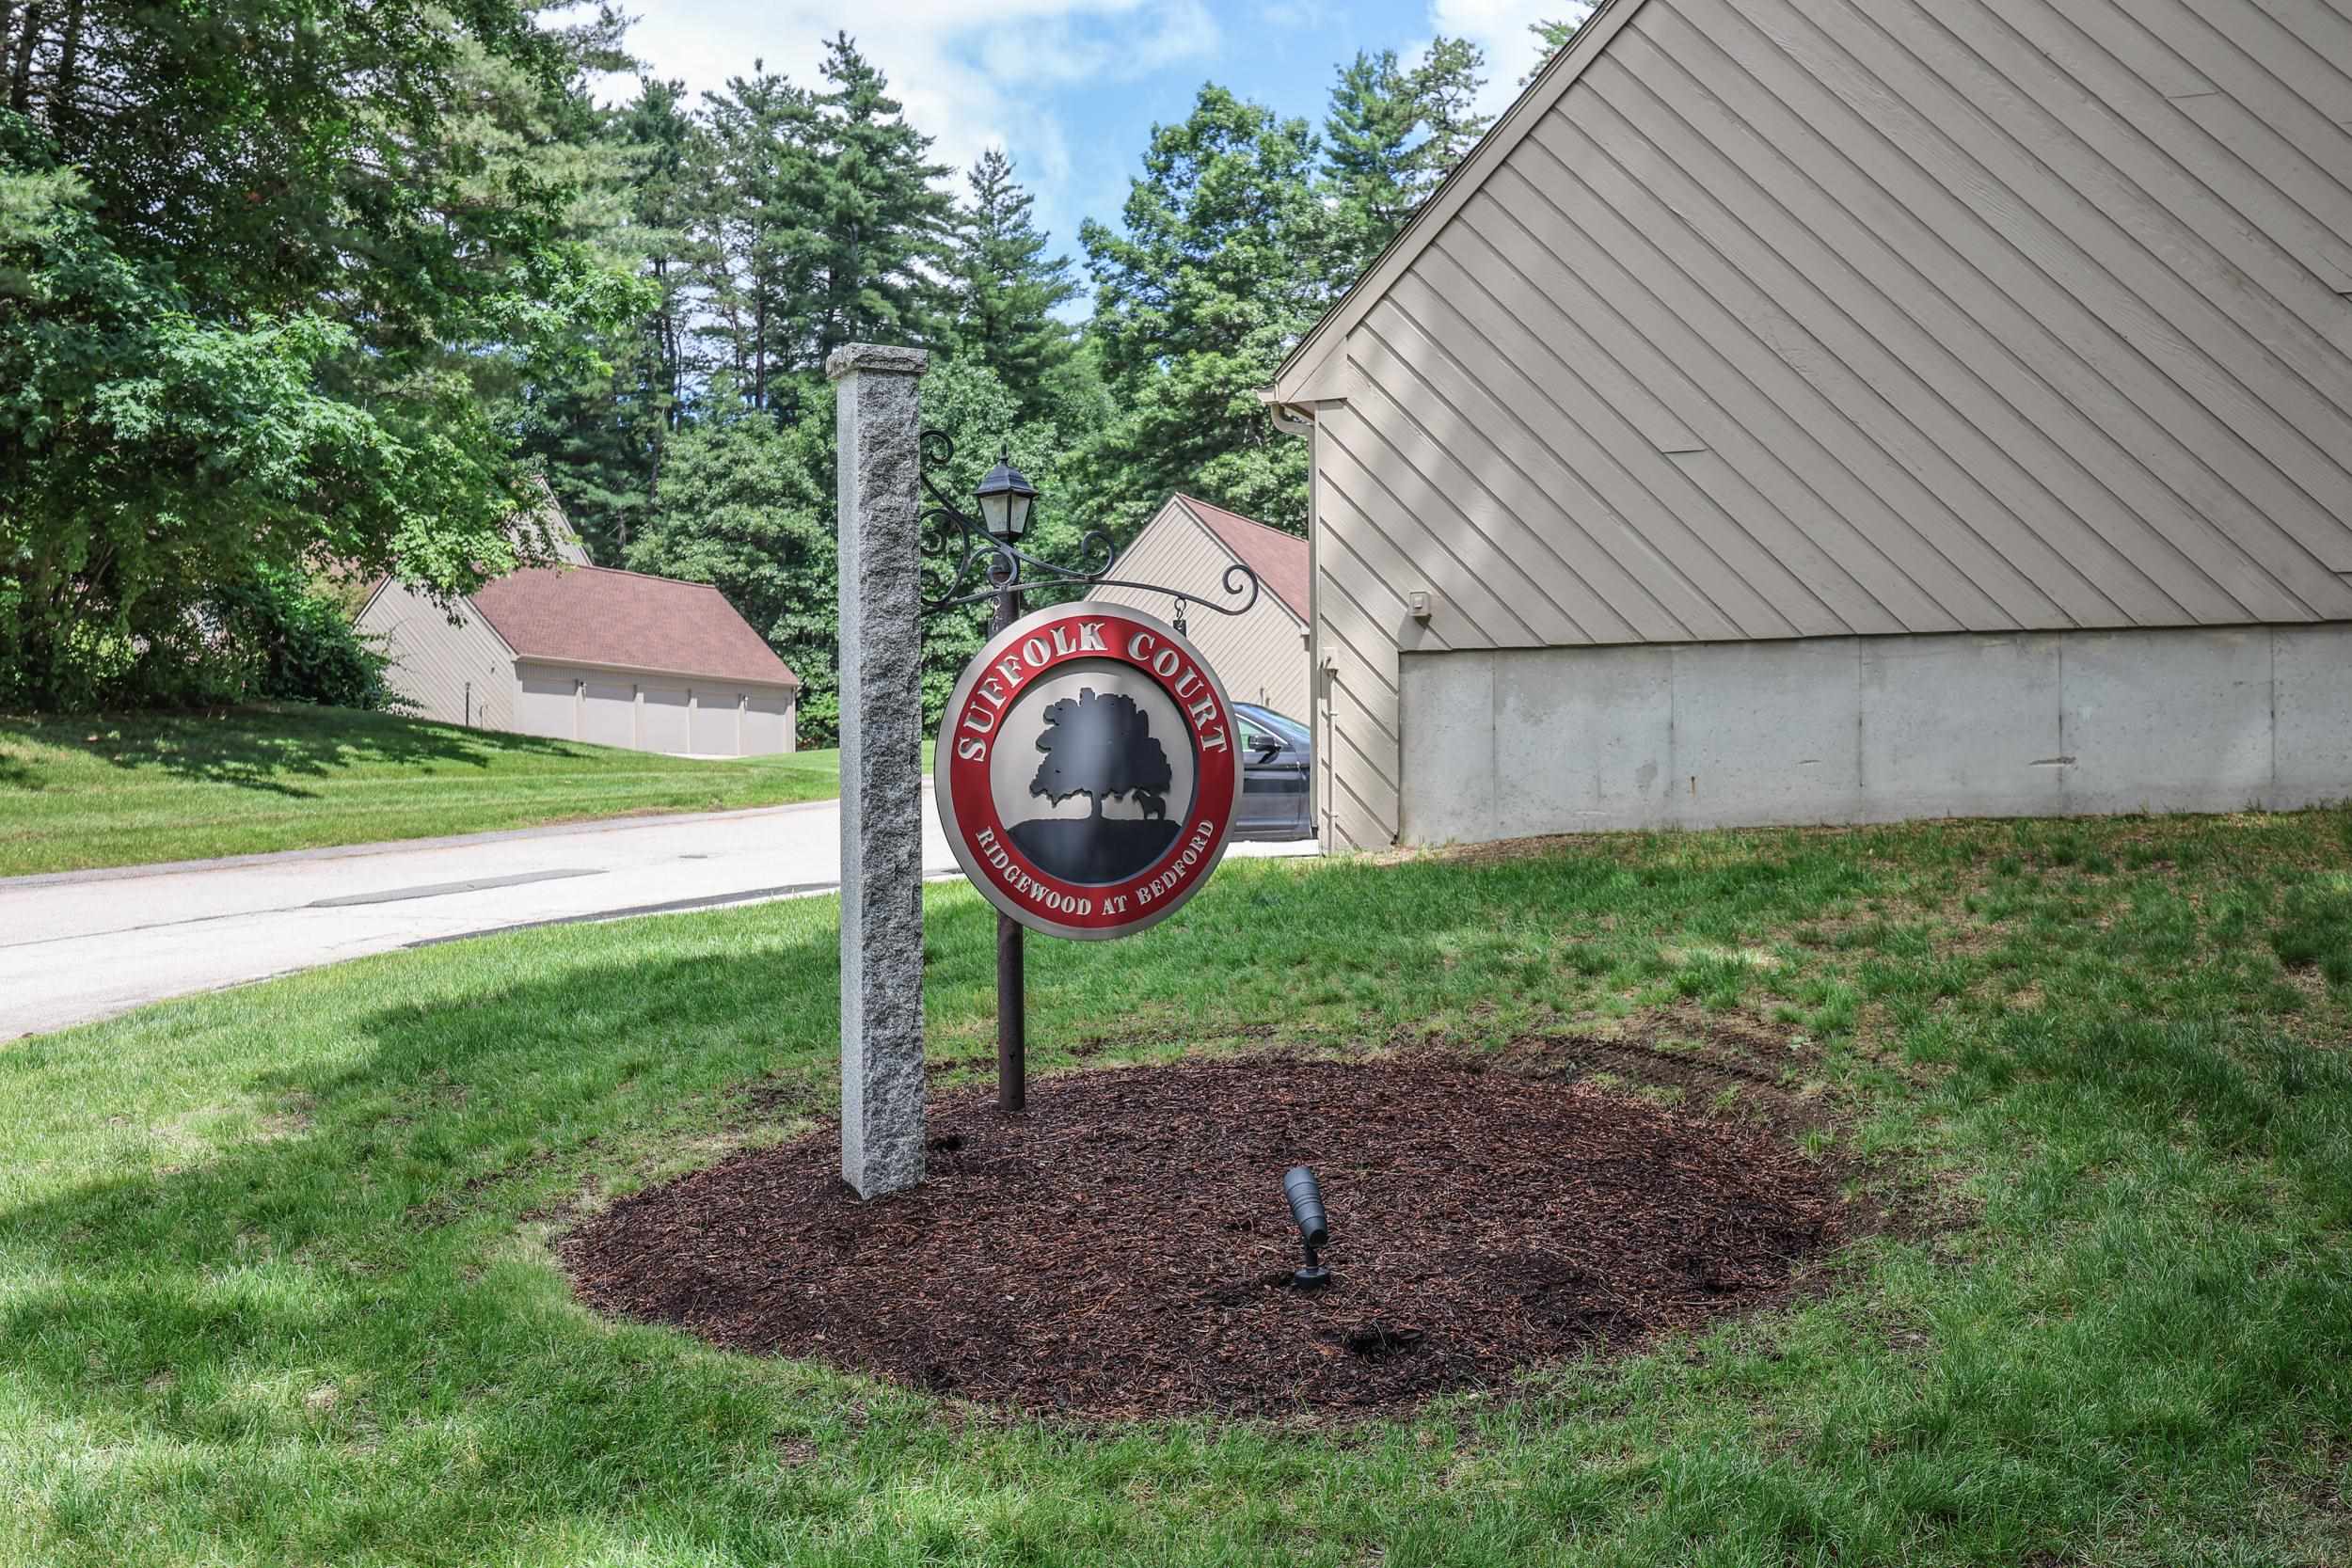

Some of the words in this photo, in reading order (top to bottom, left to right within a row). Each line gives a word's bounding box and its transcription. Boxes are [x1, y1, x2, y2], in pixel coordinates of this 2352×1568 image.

[959, 623, 1107, 762] SUFFOLK
[1129, 634, 1227, 753] COURT
[977, 827, 1091, 915] RIDGEWOOD
[1102, 895, 1128, 916] AT
[1136, 820, 1215, 905] BEDFORD
